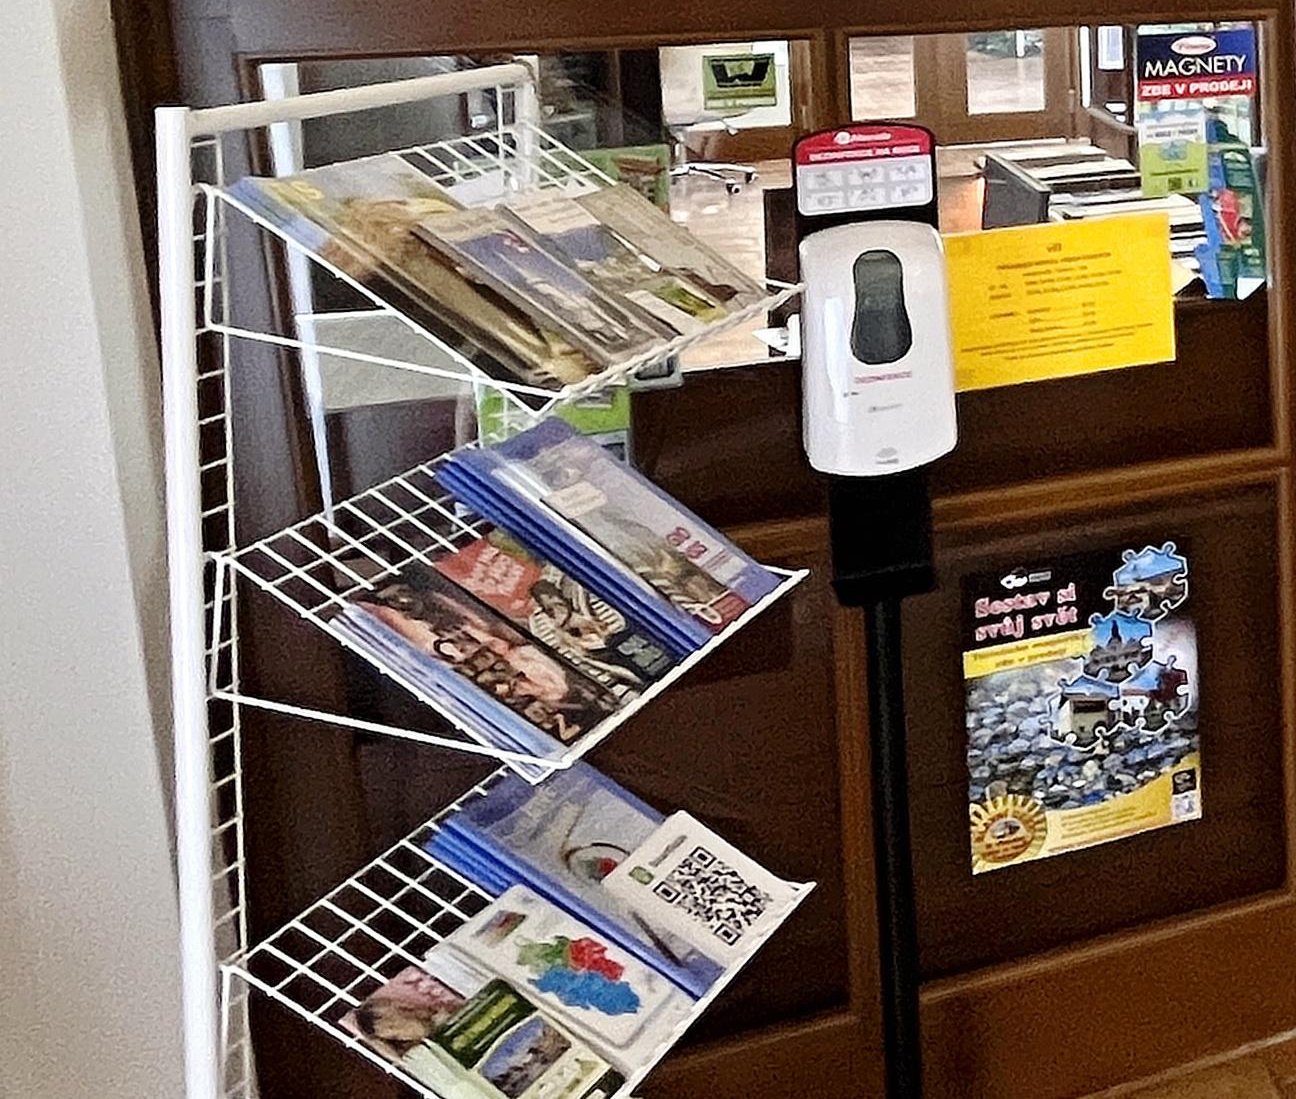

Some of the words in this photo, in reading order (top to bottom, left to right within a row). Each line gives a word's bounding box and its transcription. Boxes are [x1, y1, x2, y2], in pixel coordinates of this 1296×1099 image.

[1144, 54, 1247, 78] MAGNETY
[1174, 83, 1187, 95] V
[975, 591, 1051, 619] Sestav
[1057, 582, 1077, 604] si
[1031, 605, 1078, 631] svět
